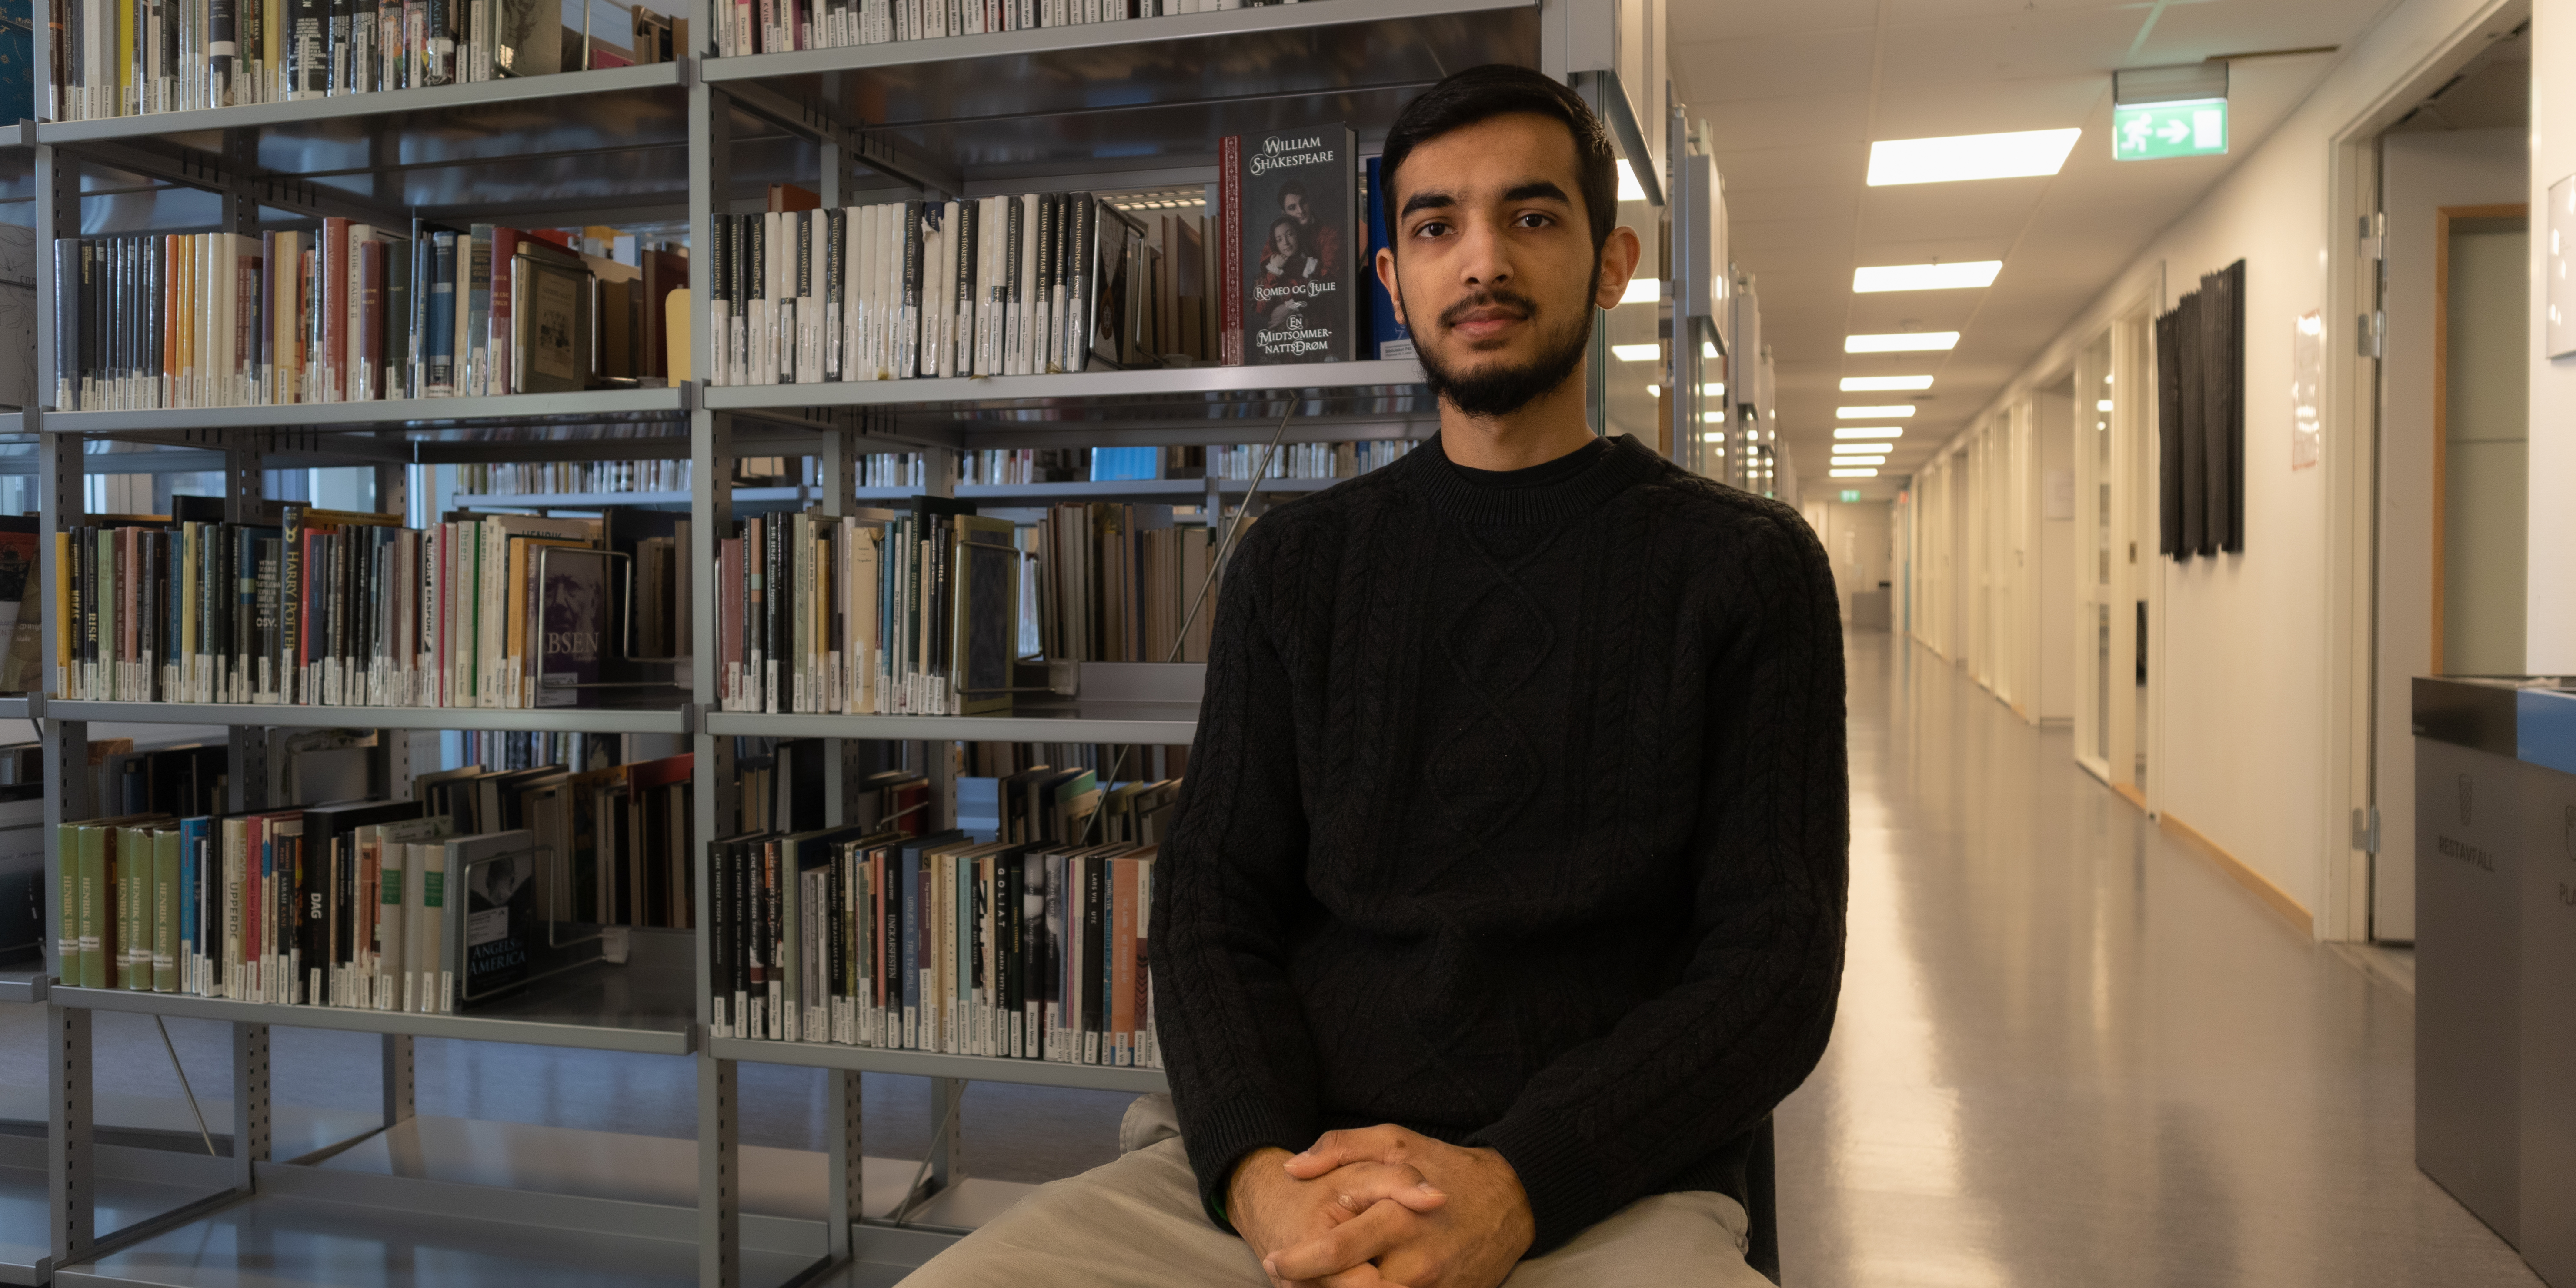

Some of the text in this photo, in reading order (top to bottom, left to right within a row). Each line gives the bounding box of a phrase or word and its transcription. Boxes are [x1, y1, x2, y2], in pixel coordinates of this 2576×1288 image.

[1263, 136, 1321, 158] WILLIAM
[1250, 150, 1334, 176] SHAKESPEARE
[1007, 206, 1016, 234] WILLIAM
[1073, 201, 1083, 230] WILLIAM
[960, 210, 968, 279] WILLIAM SHAKESPEARE
[1056, 204, 1064, 275] WILLIAM SHAKESPEARE
[1073, 230, 1083, 272] SHAKESPEARE
[1007, 235, 1016, 277] SHAKESPEARE
[1253, 279, 1336, 301] ROMEO OG JULIE
[1286, 314, 1304, 330] EN
[1256, 328, 1333, 347] MIDTSOMMER-
[1265, 339, 1328, 355] NATTSDRØM
[460, 530, 469, 561] Ibsen
[284, 551, 299, 651] HARRY POTTER
[88, 613, 97, 643] RISK
[547, 632, 599, 654] BSEN
[2439, 835, 2496, 873] RESTAVFALL
[63, 876, 72, 917] HENRIK
[159, 882, 167, 924] HENRIK
[310, 893, 321, 920] DAG
[997, 868, 1005, 928] GOLIAT
[473, 940, 515, 959] ANGELS
[887, 914, 896, 979] UNGKARSFESTEN
[468, 951, 525, 975] AMERICA
